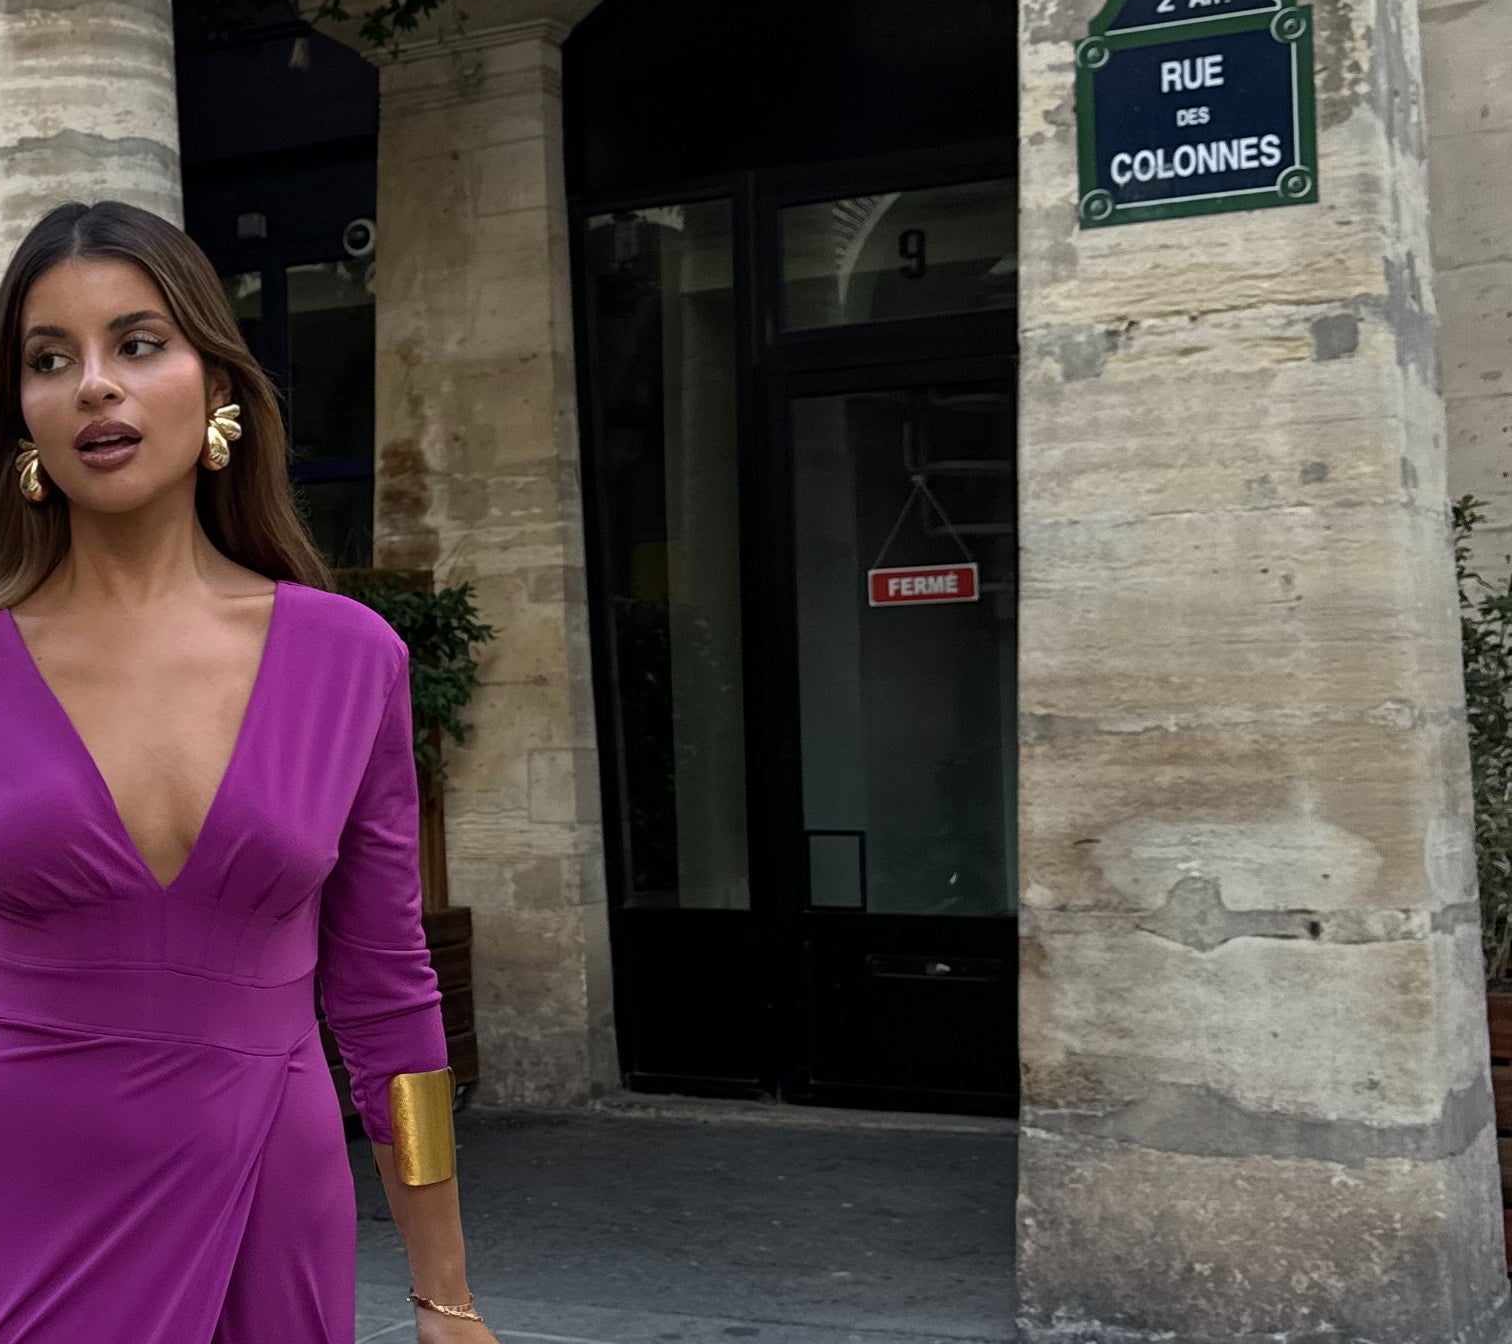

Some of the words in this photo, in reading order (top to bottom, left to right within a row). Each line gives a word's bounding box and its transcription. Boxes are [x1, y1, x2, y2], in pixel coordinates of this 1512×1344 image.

[1160, 54, 1224, 93] RUE
[1176, 106, 1210, 127] DES
[1110, 134, 1282, 184] COLONNES
[898, 229, 926, 278] 9
[888, 571, 959, 597] FERMÉ
